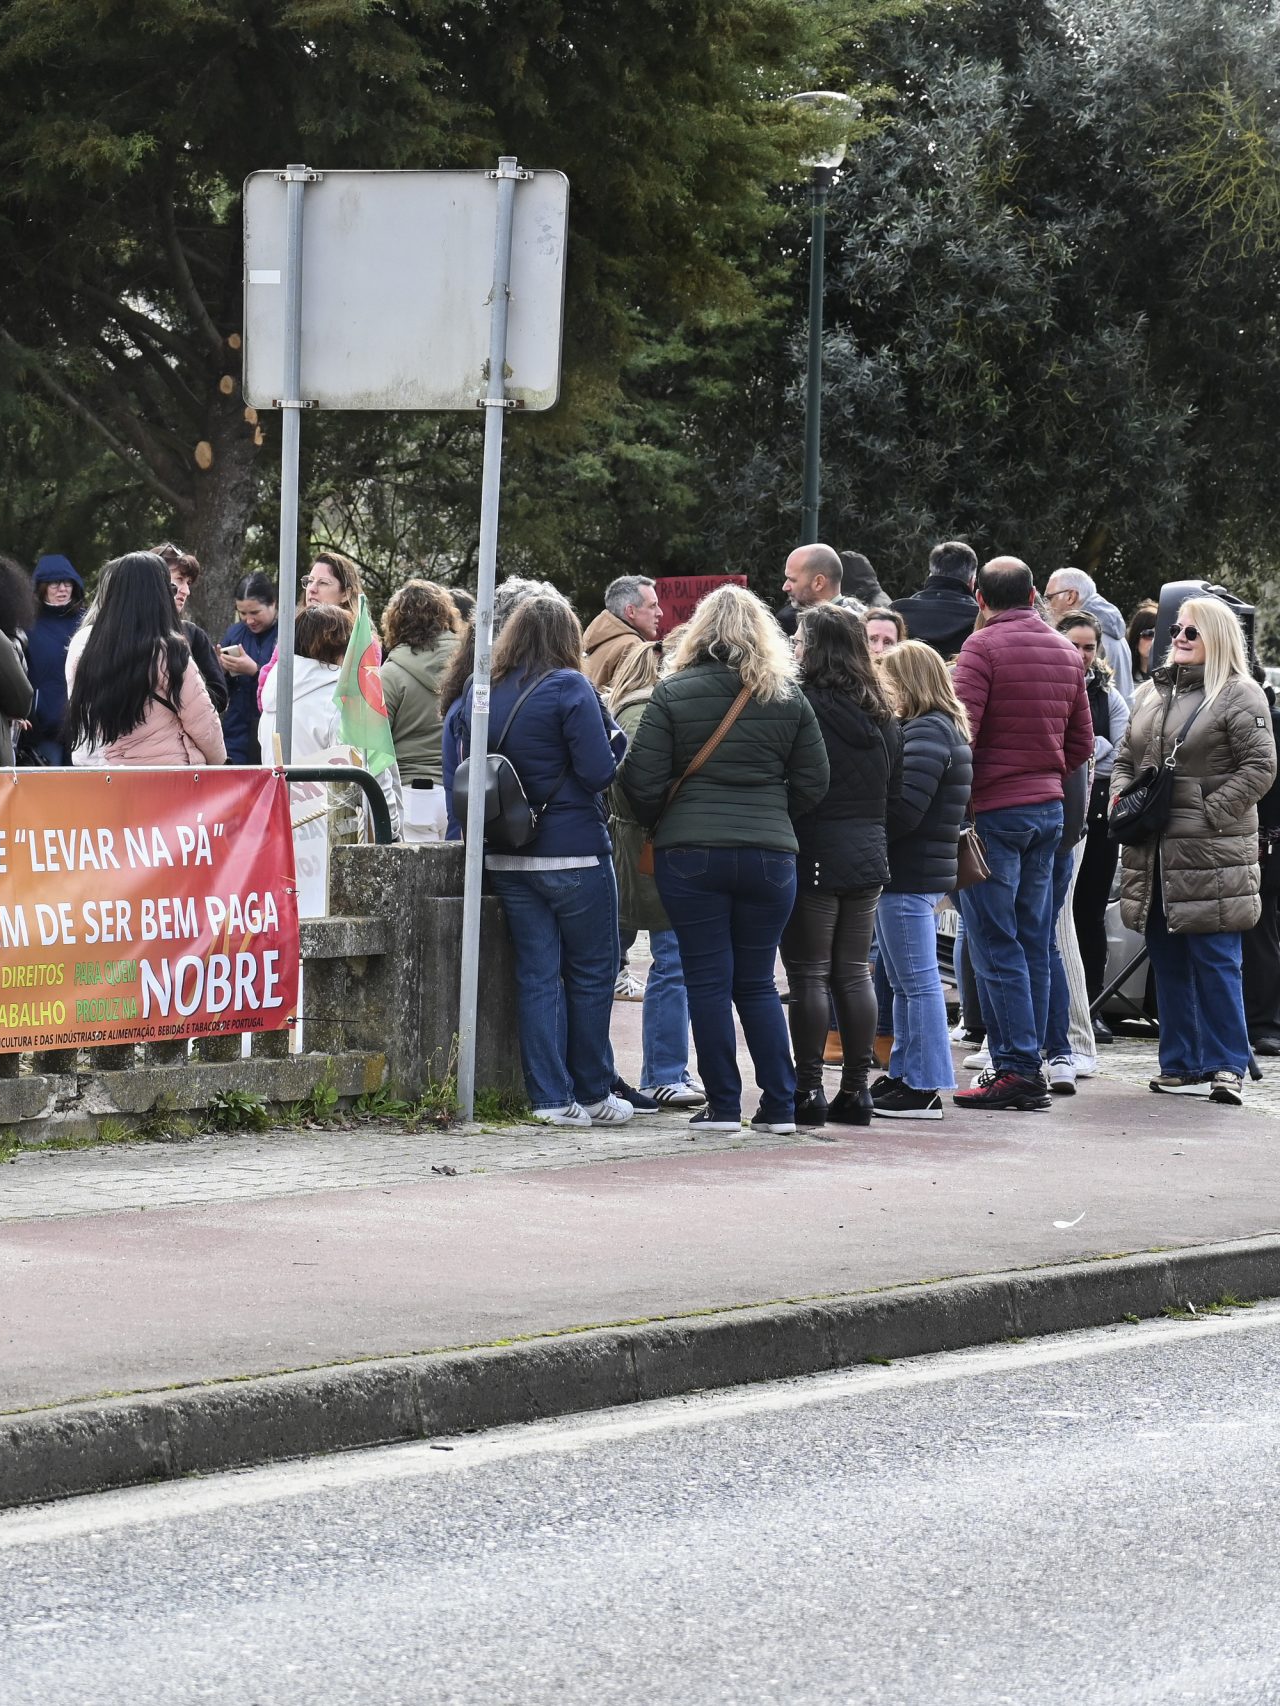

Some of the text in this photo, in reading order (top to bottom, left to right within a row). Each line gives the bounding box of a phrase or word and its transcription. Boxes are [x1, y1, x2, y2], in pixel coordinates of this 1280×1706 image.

[124, 826, 173, 870] NA
[36, 902, 76, 946] DE
[82, 898, 133, 943] SER
[140, 895, 199, 940] BEM
[204, 891, 279, 937] PAGA
[1, 962, 65, 989] DIREITOS
[73, 961, 102, 987] PARA
[104, 959, 137, 986] QUEM
[139, 948, 284, 1019] NOBRE
[34, 1035, 39, 1046] E
[39, 1034, 53, 1045] DAS
[55, 1030, 96, 1044] INDÚSTRIAS
[97, 1031, 108, 1040] DE
[108, 1025, 156, 1040] ALIMENTAÇÃO,
[157, 1023, 186, 1036] BEBIDAS
[186, 1023, 191, 1033] E
[191, 1020, 220, 1033] TABACOS
[221, 1020, 230, 1030] DE
[231, 1017, 264, 1029] PORTUGAL
[75, 999, 120, 1024] PRODUZ
[122, 997, 138, 1020] NA
